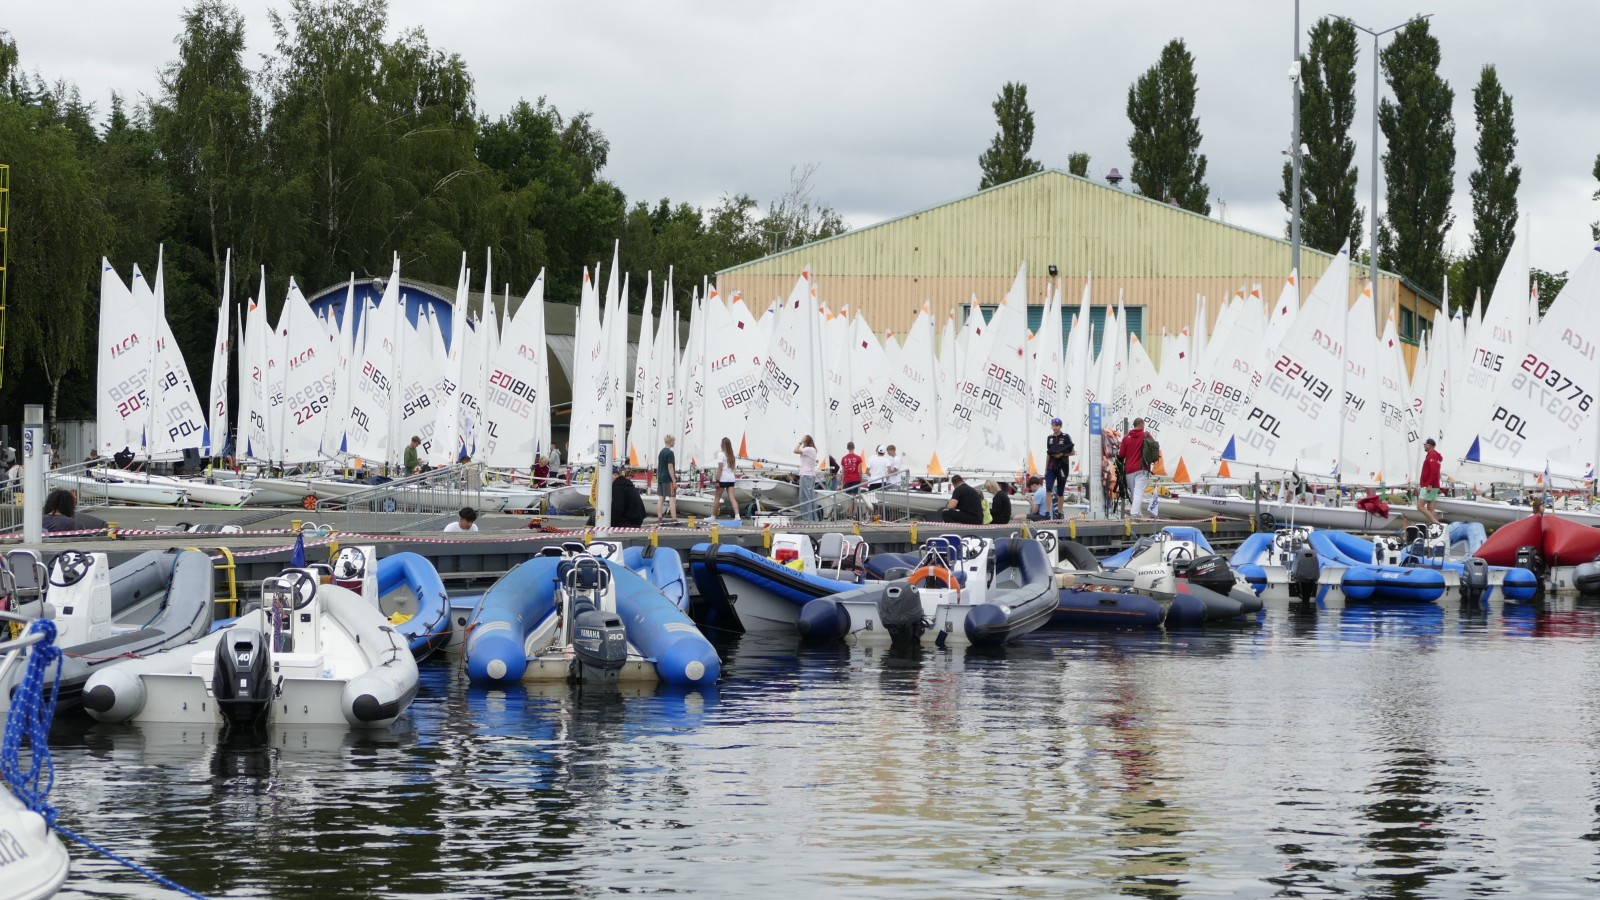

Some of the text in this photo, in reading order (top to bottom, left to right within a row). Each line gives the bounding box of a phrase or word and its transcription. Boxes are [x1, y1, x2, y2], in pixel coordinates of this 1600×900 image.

[110, 333, 140, 360] ILCA
[289, 347, 316, 371] ILCA
[711, 353, 737, 373] ILCA
[765, 356, 800, 396] 205297
[1274, 354, 1333, 403] 224131
[1520, 353, 1594, 412] 203776
[887, 382, 921, 412] 219623
[981, 389, 1003, 410] POL
[1037, 397, 1054, 418] POL
[350, 406, 370, 432] POL
[879, 404, 894, 423] POL
[952, 403, 972, 422] POL
[1200, 404, 1226, 426] POL
[1247, 406, 1282, 439] POL
[1491, 406, 1527, 440] POL
[168, 419, 202, 443] POL
[1196, 562, 1215, 570] SUZUKI
[581, 628, 600, 639] YAMAHA
[608, 633, 624, 641] 40
[237, 653, 250, 662] 40
